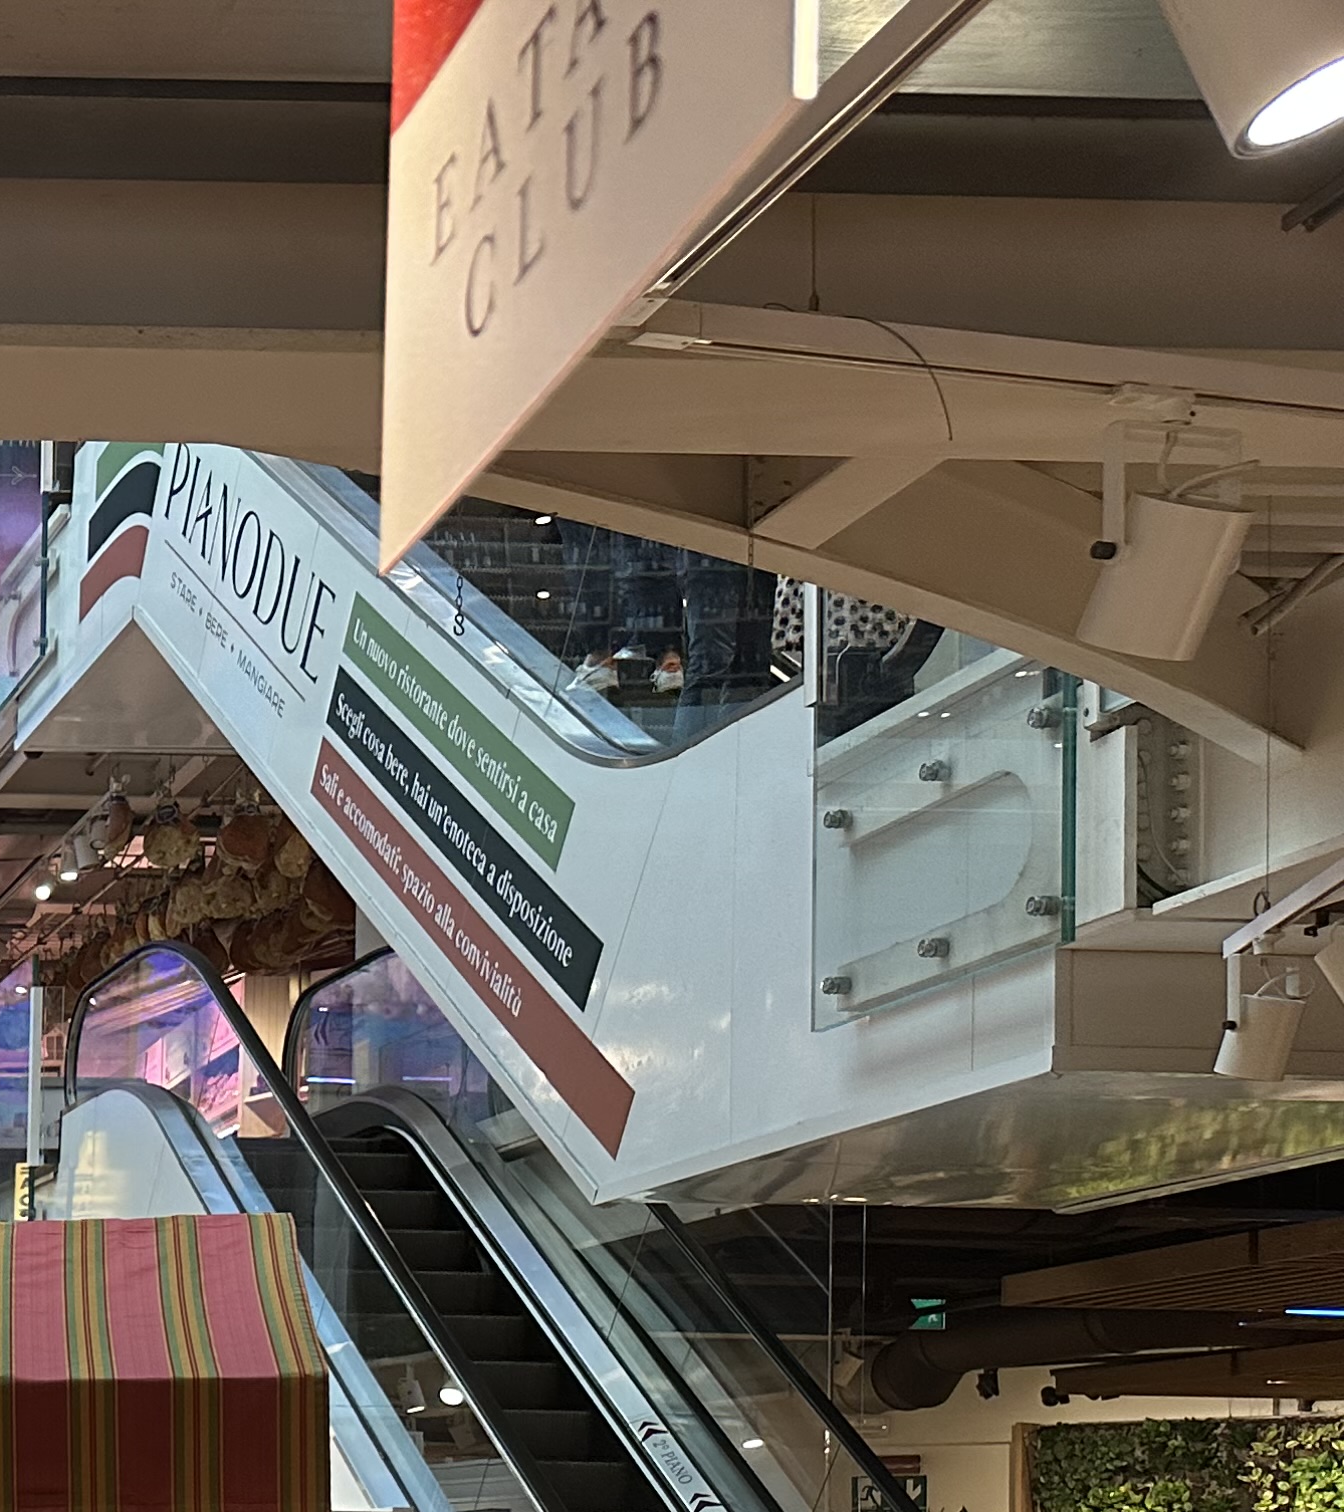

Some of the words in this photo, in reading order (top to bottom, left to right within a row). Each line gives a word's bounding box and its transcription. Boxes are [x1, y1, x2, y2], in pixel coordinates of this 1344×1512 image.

[464, 10, 662, 338] CLUB
[164, 443, 336, 684] PIANODUE
[170, 571, 197, 613] STARE
[205, 612, 229, 650] BERE
[236, 649, 286, 719] MANGIARE
[335, 691, 363, 741] Scegli
[363, 724, 386, 766] cosa
[386, 744, 410, 797] bere,
[411, 772, 430, 811] hai
[487, 862, 497, 887] a
[497, 869, 575, 969] disposizione
[353, 617, 367, 648] Un
[368, 636, 397, 681] nuovo
[396, 664, 449, 732] ristorante
[448, 714, 476, 760] dove
[474, 745, 517, 804] sentirsi
[519, 790, 528, 813] a
[529, 803, 557, 844] casa
[319, 763, 338, 798] Sali
[337, 785, 344, 806] e
[401, 860, 435, 916] spazio
[434, 900, 455, 941] alla
[662, 1451, 693, 1485] PIANO
